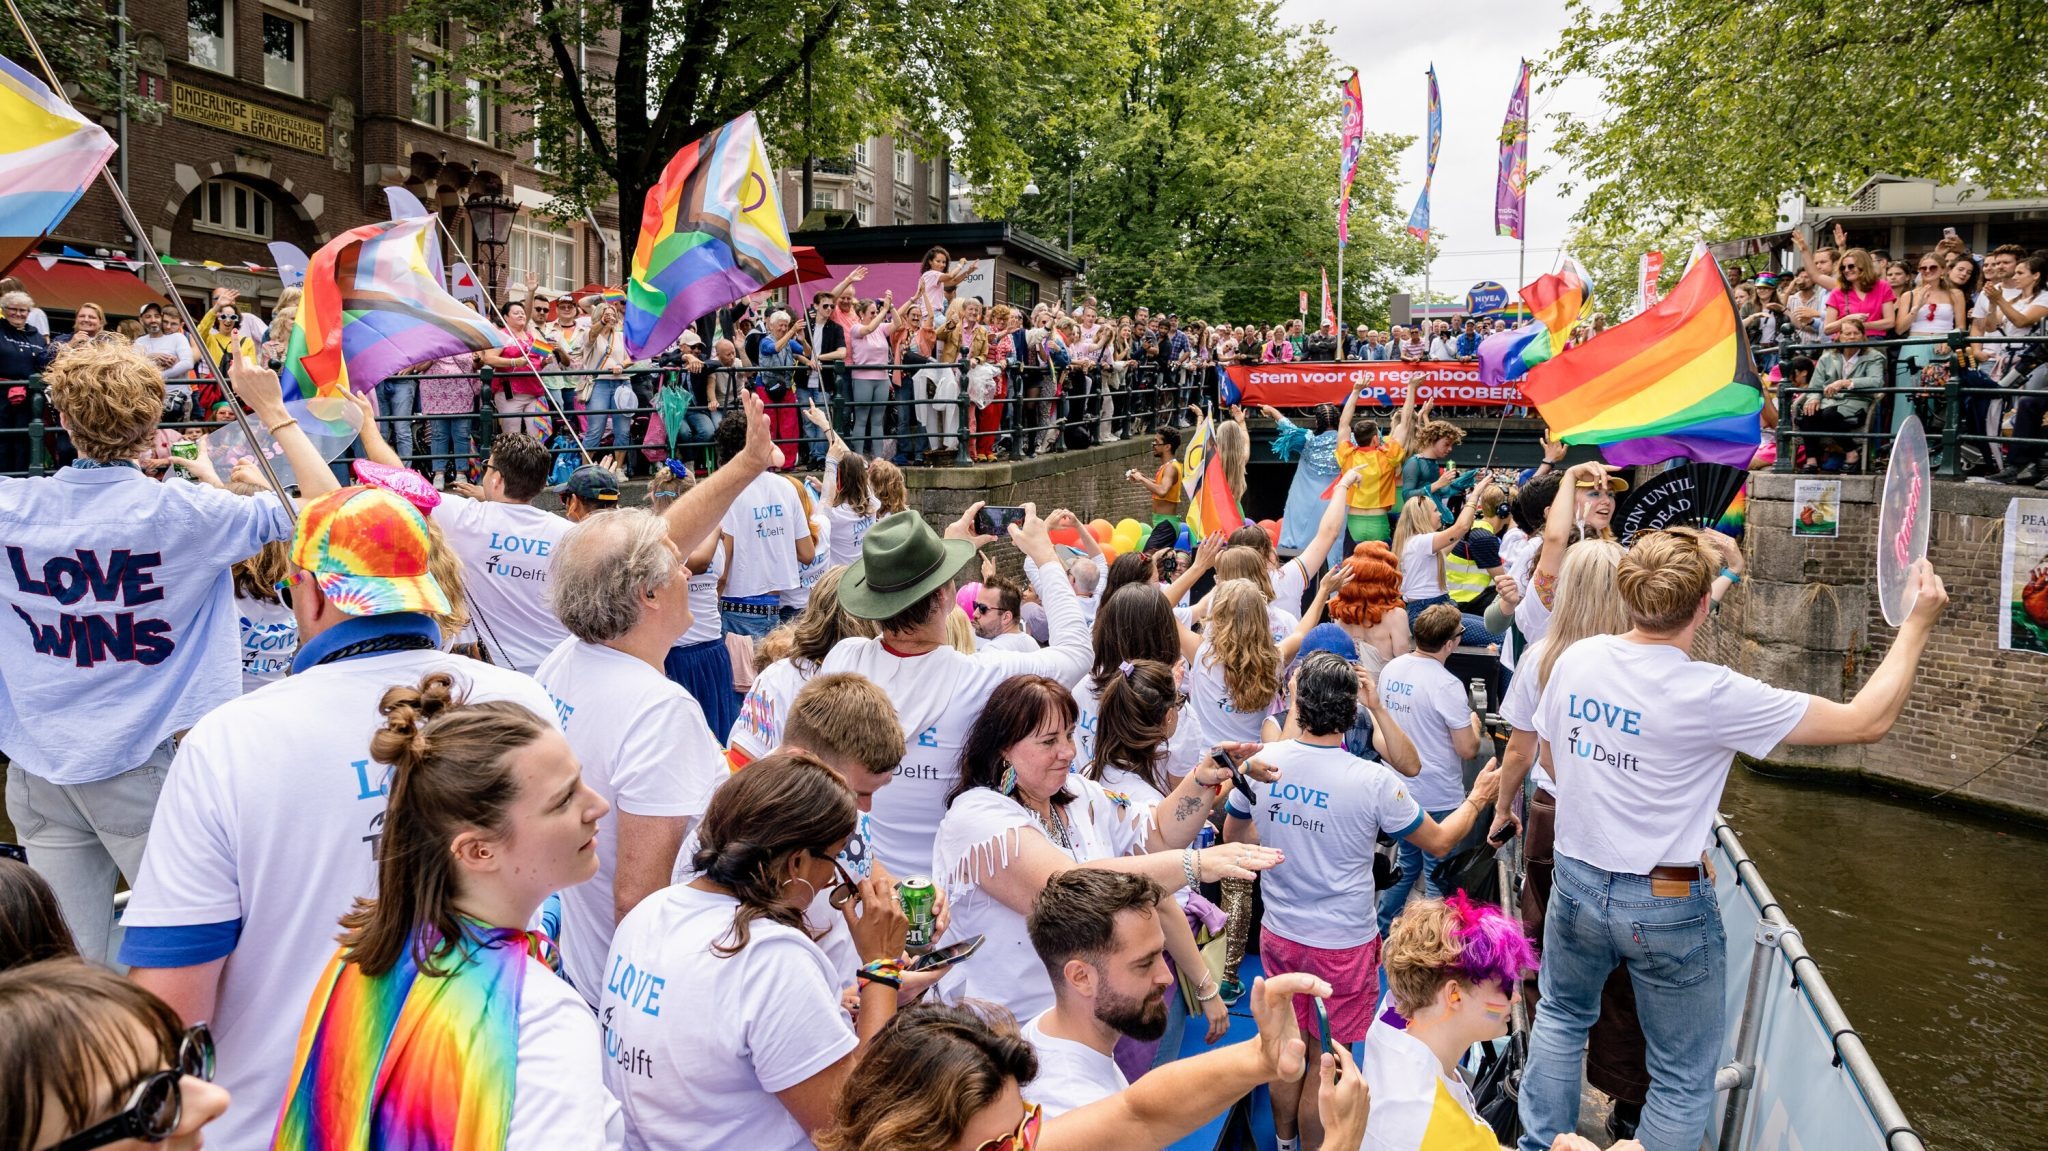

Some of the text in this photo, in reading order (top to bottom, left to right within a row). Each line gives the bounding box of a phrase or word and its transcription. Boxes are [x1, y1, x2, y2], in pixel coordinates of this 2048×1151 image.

[176, 86, 247, 118] ONDERLINGE
[1250, 372, 1298, 384] Stem
[1301, 372, 1346, 383] voor
[1359, 387, 1386, 399] OP
[1642, 478, 1695, 505] UNTIL
[753, 504, 783, 520] LOVE
[1649, 498, 1691, 530] DEAD
[2020, 514, 2048, 526] PEA
[489, 532, 551, 557] LOVE
[5, 545, 165, 607] LOVE
[11, 603, 176, 668] WINS
[1386, 679, 1413, 696] LOVE
[1568, 694, 1642, 736] LOVE
[1269, 781, 1330, 809] LOVE
[608, 954, 665, 1017] LOVE
